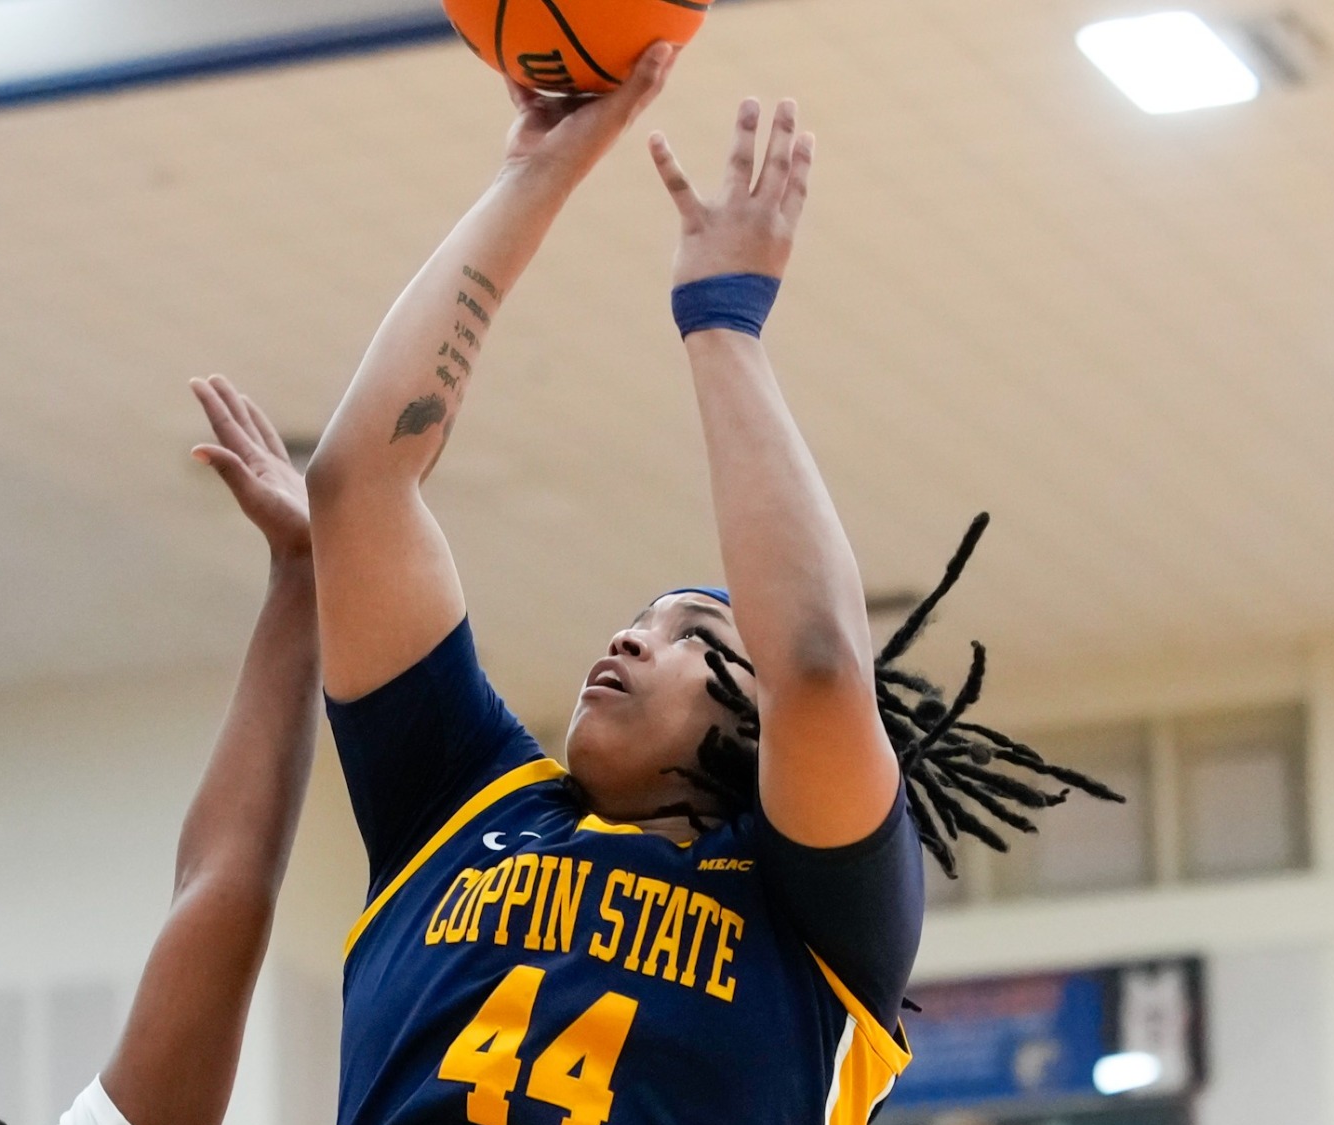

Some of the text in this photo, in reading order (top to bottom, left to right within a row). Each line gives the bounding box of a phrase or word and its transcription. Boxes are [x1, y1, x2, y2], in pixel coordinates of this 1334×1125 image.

[697, 858, 754, 871] MEAC
[425, 853, 744, 1003] COPPIN STATE
